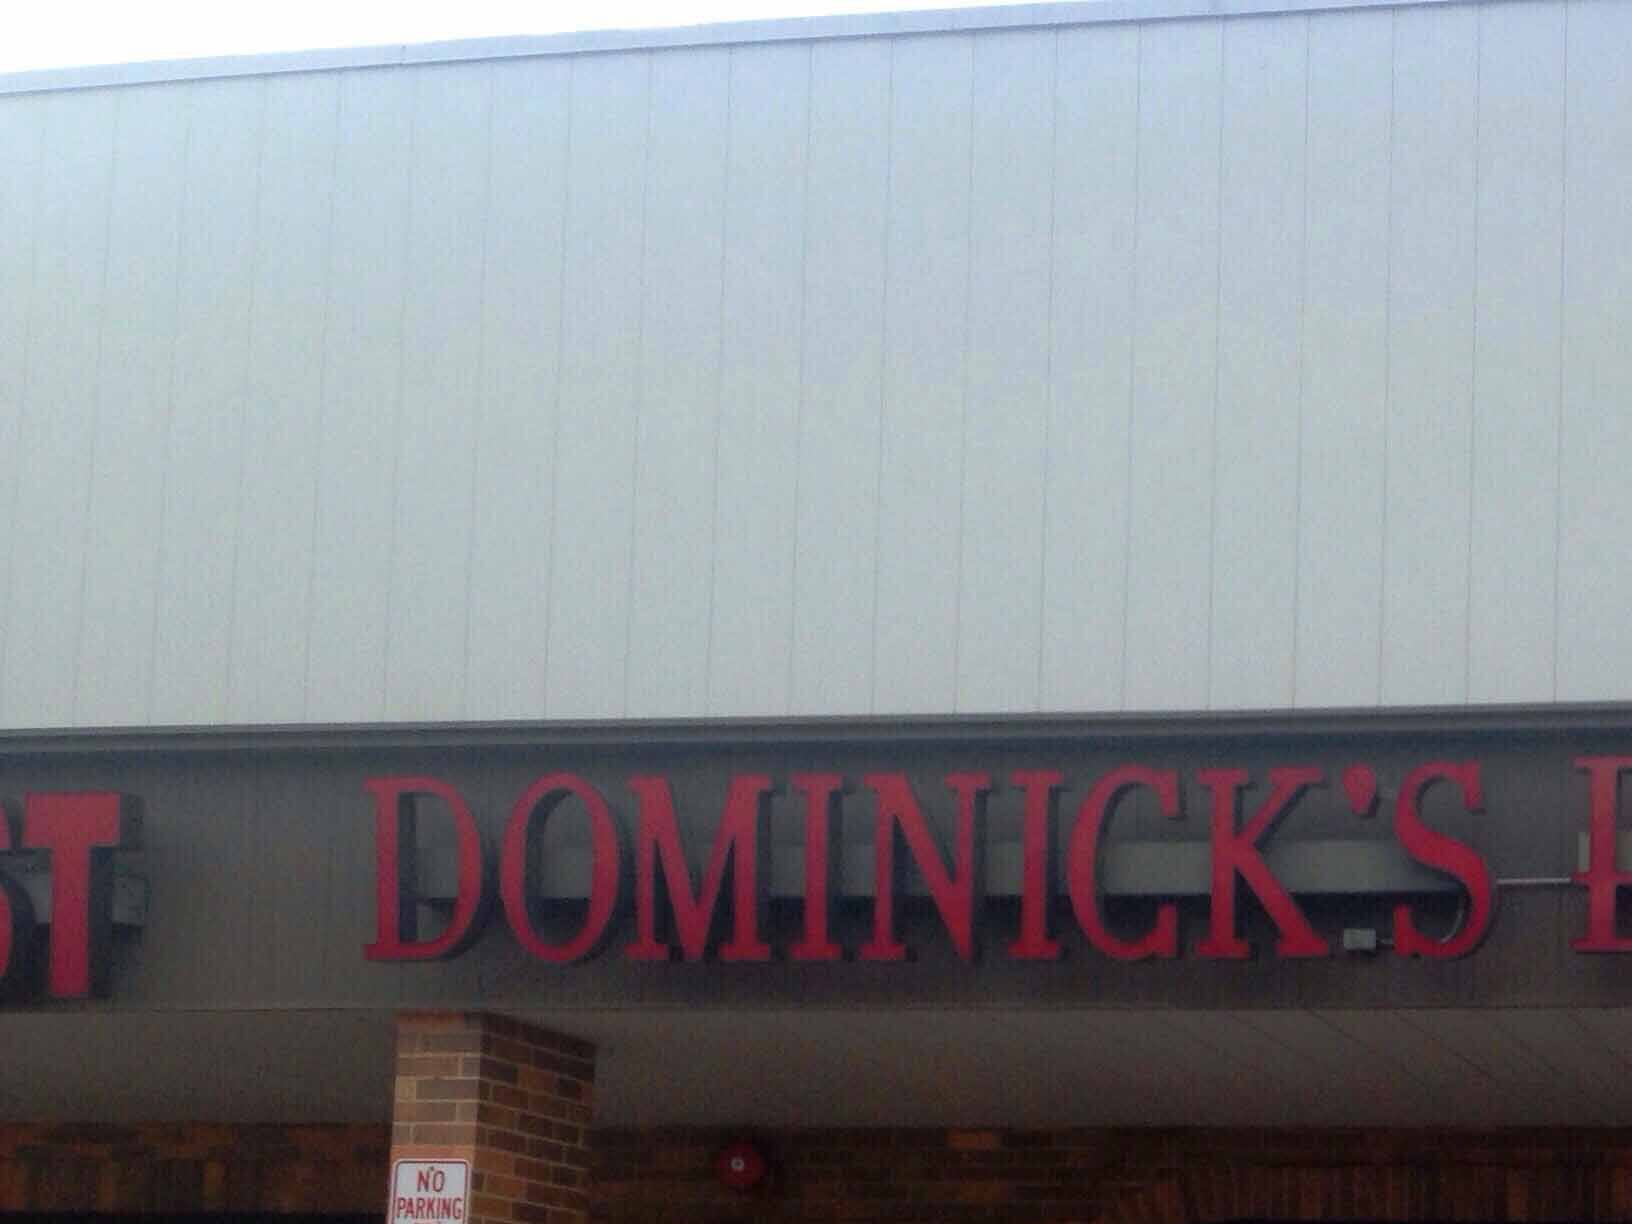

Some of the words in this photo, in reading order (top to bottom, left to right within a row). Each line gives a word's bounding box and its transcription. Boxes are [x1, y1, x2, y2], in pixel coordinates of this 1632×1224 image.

[0, 790, 121, 998] T
[362, 761, 1495, 962] DOMINICK'S
[397, 1196, 464, 1220] PARKING
[416, 1169, 446, 1192] NO
